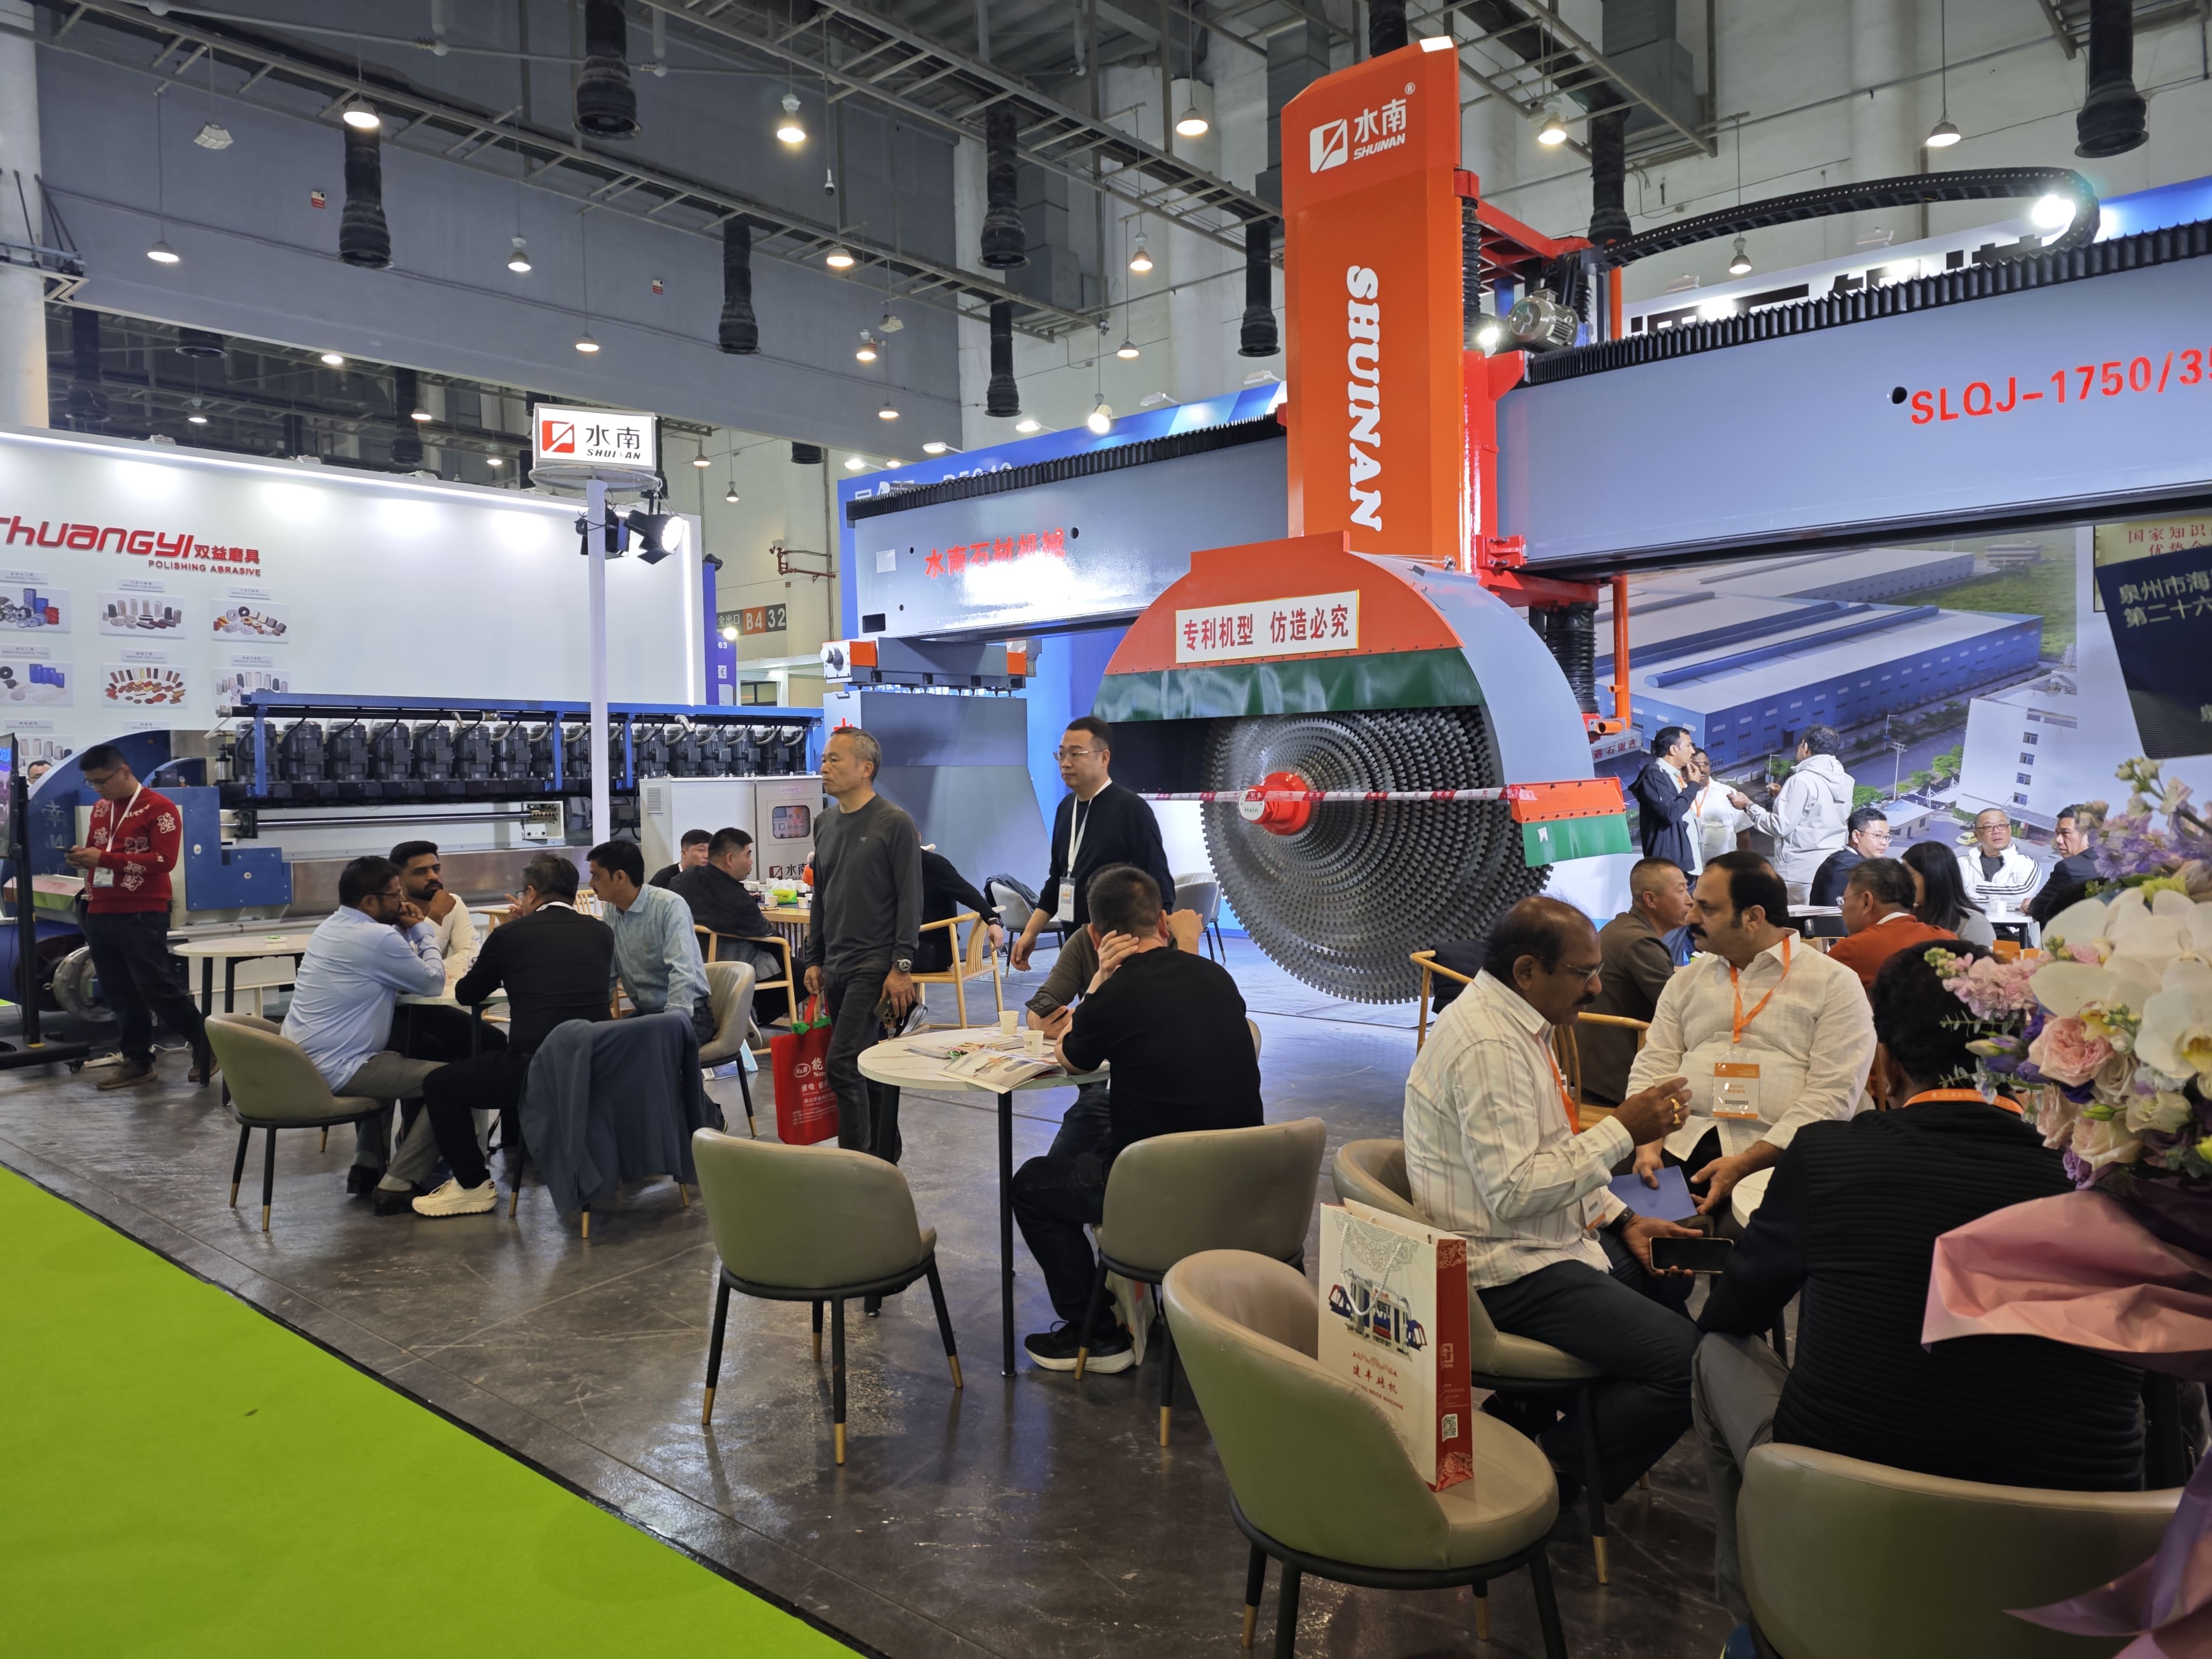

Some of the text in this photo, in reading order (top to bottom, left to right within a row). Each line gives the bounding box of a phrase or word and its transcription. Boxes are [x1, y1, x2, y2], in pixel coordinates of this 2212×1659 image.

[1354, 99, 1406, 143] 水南
[1353, 133, 1405, 160] SHUINAN
[1911, 346, 2212, 424] SLQJ-1750/3
[1347, 265, 1382, 532] SHUINAN
[586, 424, 640, 450] 水南
[586, 449, 640, 460] SHUIAN
[2128, 524, 2212, 543] 国家知识
[194, 544, 260, 564] 双益磨具
[149, 560, 261, 577] POLISHING ABRASIVE
[2119, 569, 2212, 604] 泉州市海
[718, 608, 786, 631] 全出口 B4 32
[1184, 604, 1348, 651] 专利机型 仿造必究
